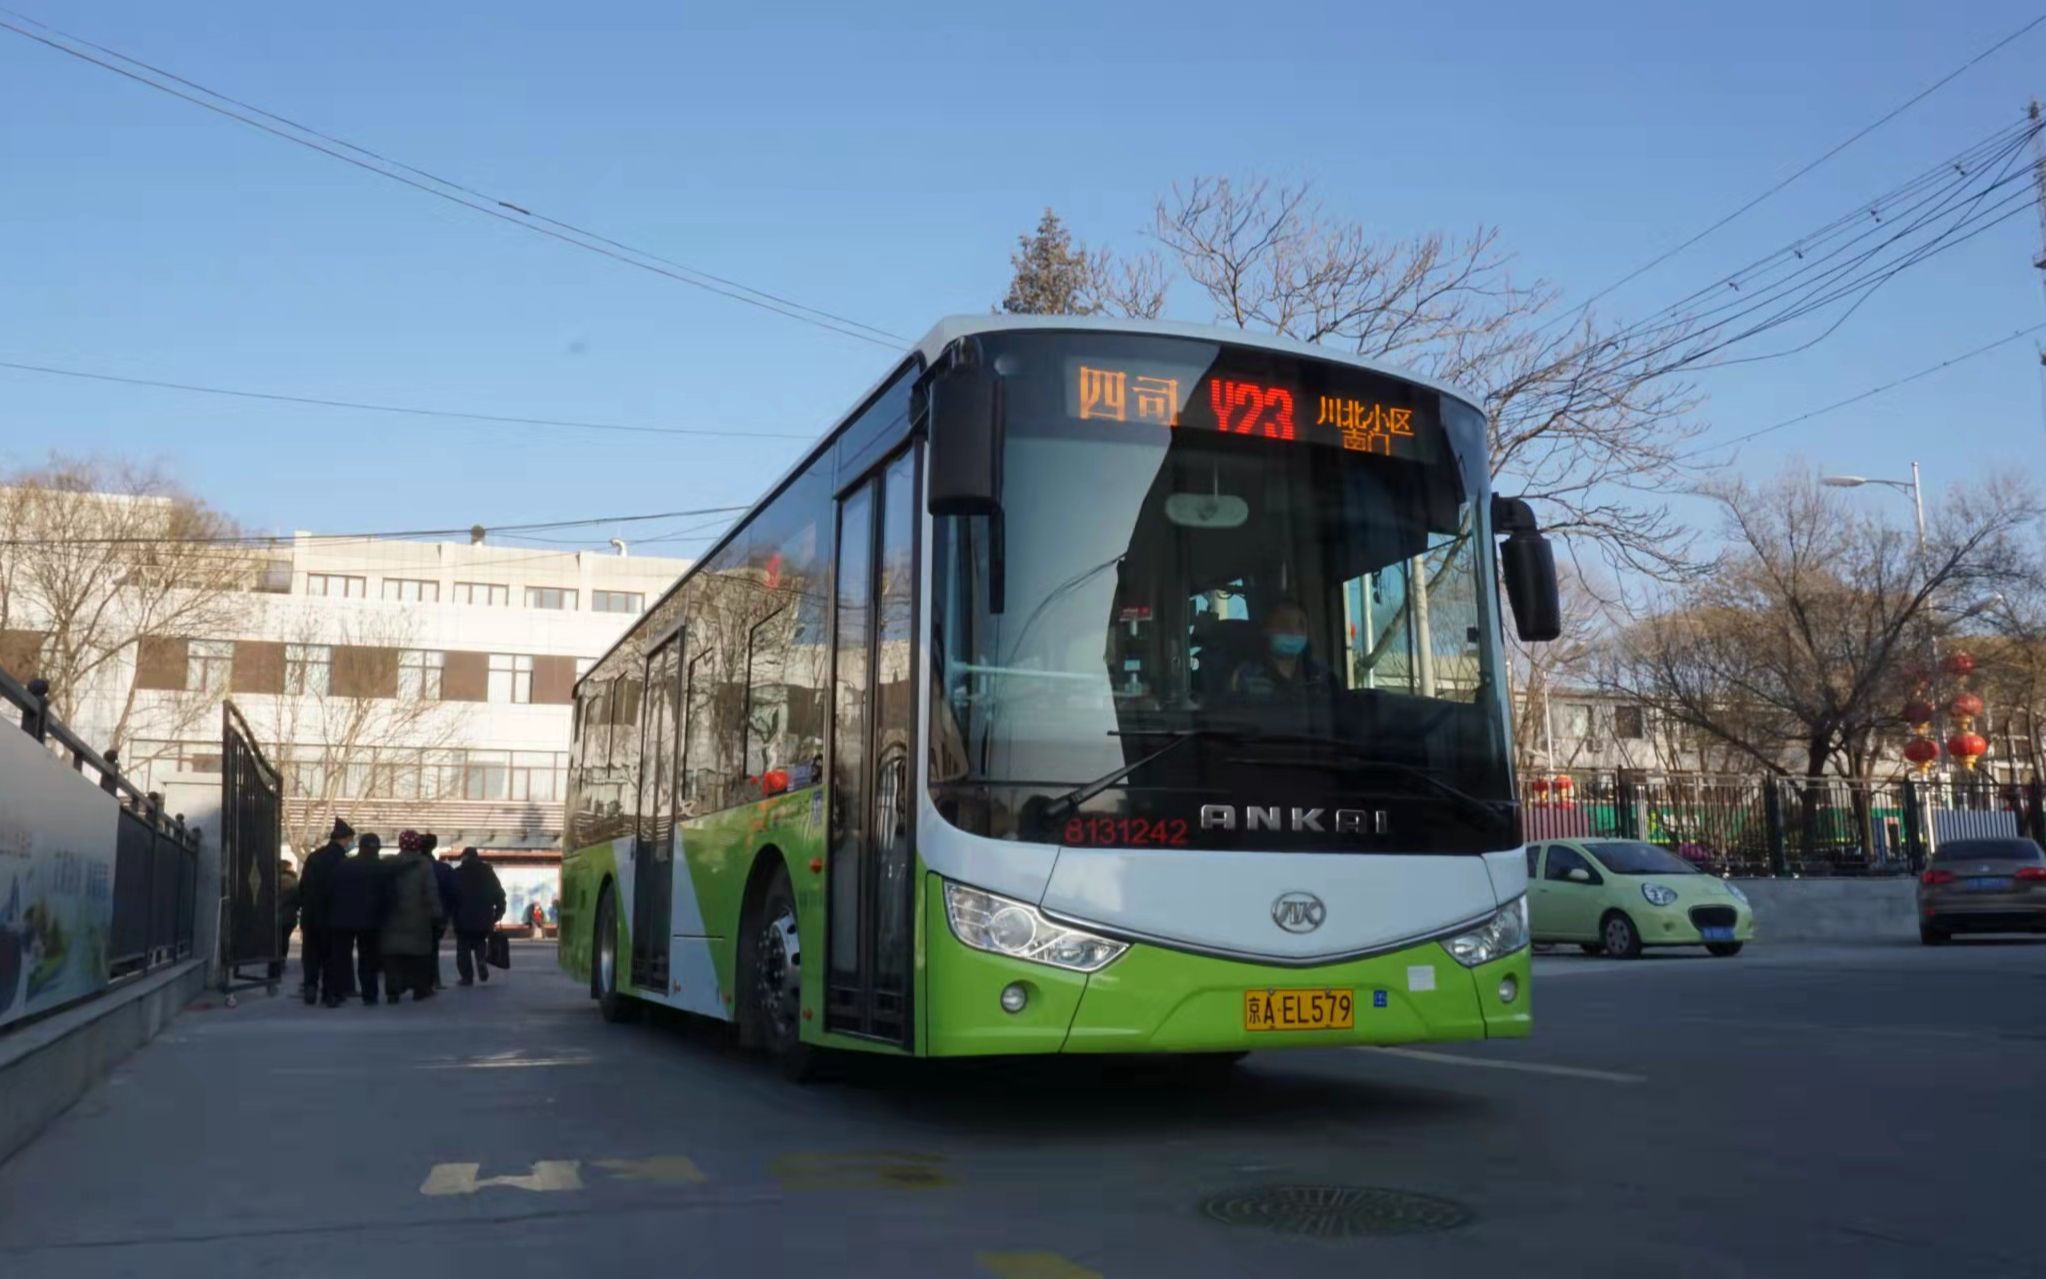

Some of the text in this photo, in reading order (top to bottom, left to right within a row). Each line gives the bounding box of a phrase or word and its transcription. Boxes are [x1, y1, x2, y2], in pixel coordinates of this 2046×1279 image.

[1079, 366, 1179, 427] 四司
[1211, 377, 1295, 440] Y23
[1316, 395, 1415, 436] 川北小区
[1341, 428, 1391, 456] 南门
[1064, 818, 1188, 845] 8131242
[1200, 804, 1388, 833] ANKAI
